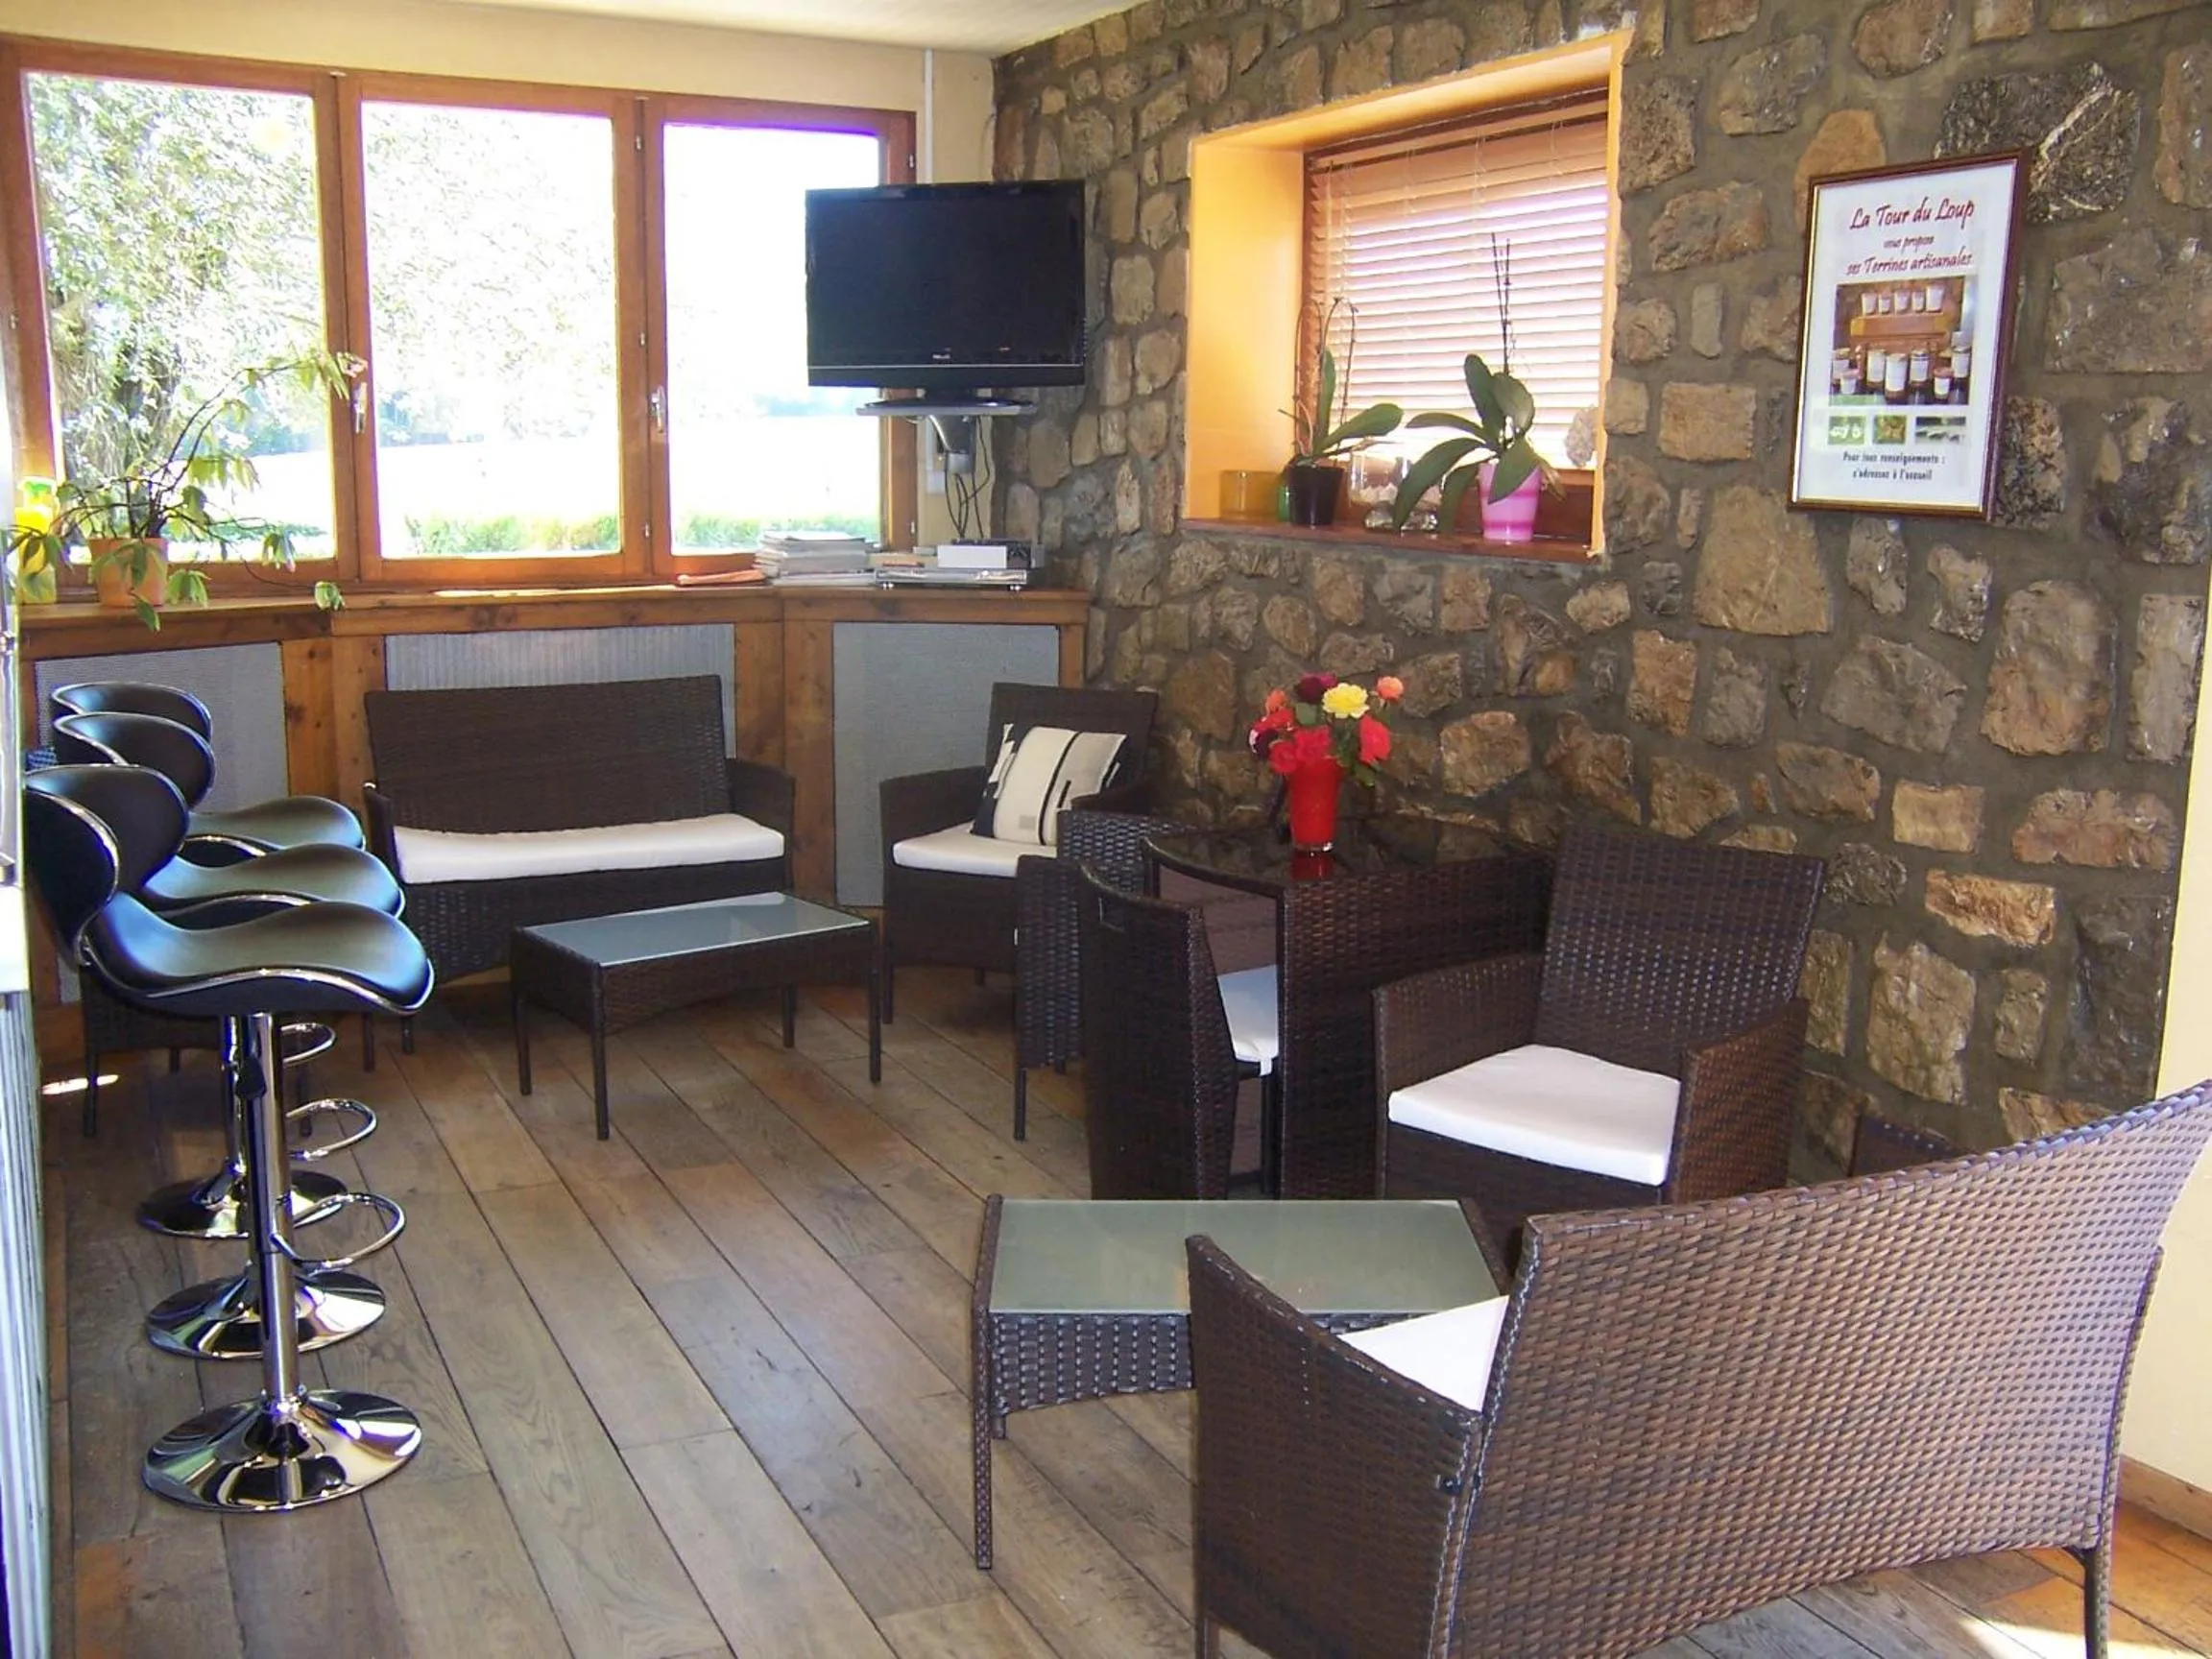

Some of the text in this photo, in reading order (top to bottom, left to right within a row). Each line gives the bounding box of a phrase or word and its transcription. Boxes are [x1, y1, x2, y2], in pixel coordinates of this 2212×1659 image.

[1849, 196, 1975, 230] La Tour du Loup
[1847, 246, 1973, 275] ses Terrines artisanales
[1843, 451, 1859, 461] Pour
